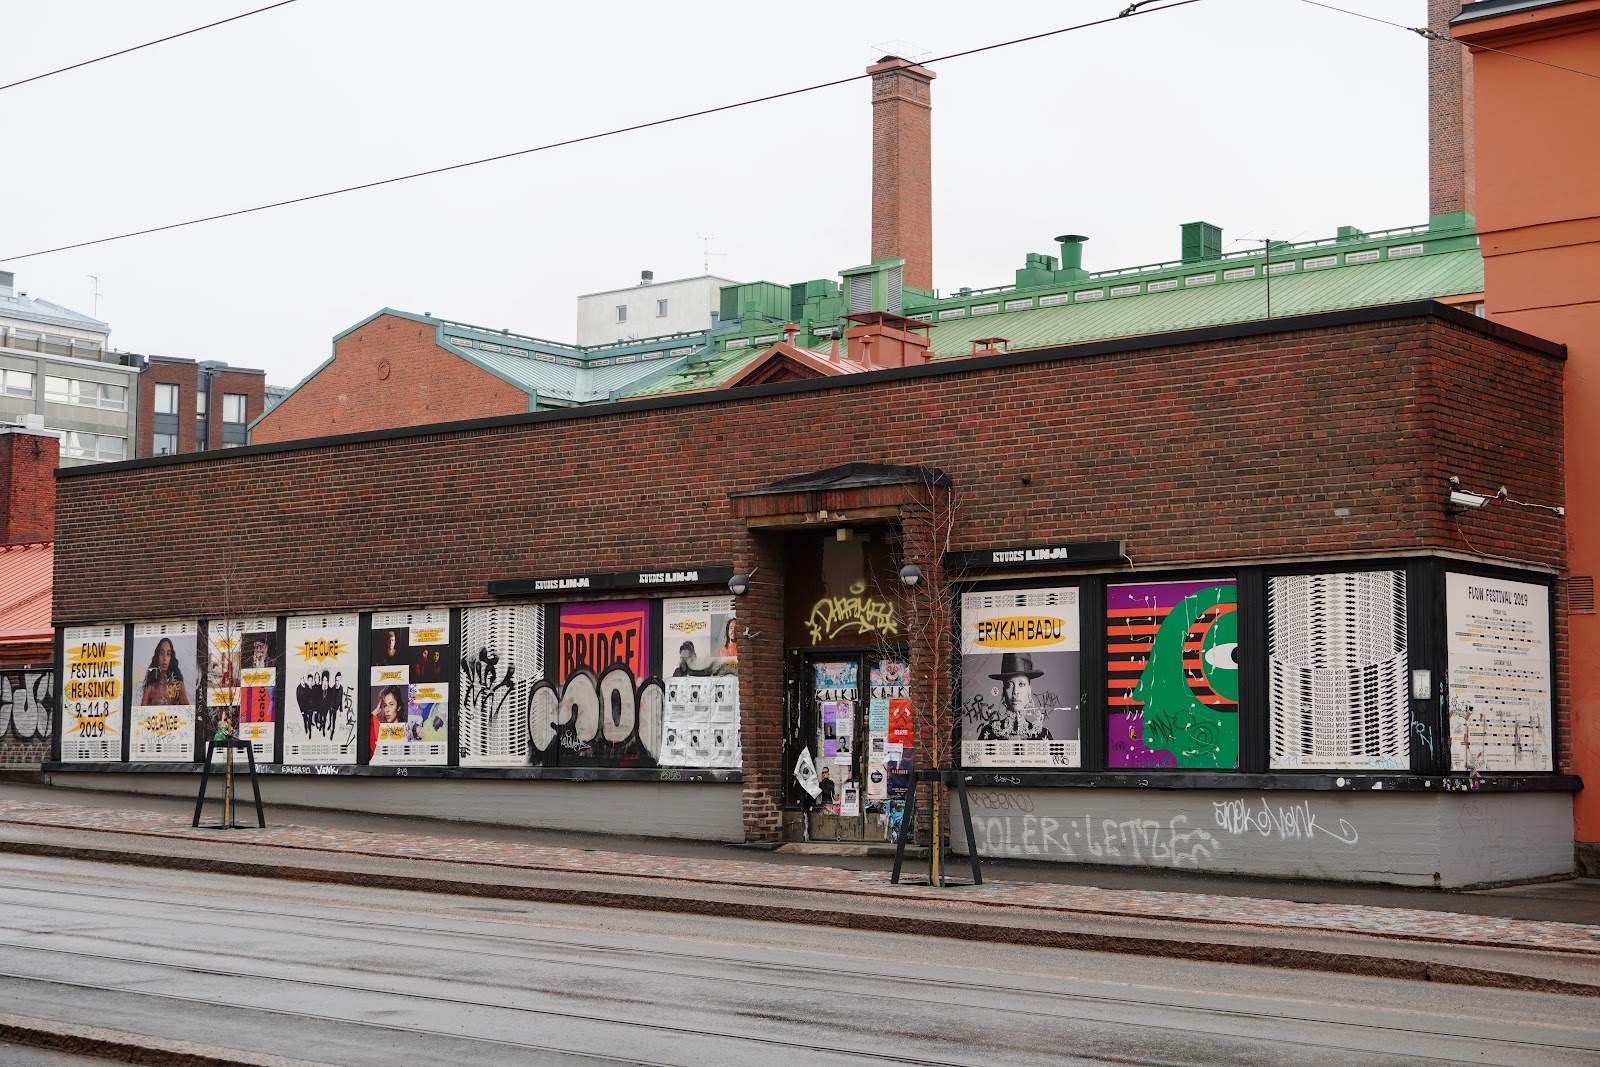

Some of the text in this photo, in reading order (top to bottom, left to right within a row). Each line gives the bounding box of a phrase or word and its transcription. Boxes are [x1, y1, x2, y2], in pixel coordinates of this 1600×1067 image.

[1026, 548, 1068, 560] LINJA
[559, 578, 590, 588] LINJA
[665, 571, 698, 582] LINJA
[1468, 586, 1528, 606] FLOW FESTIVAL 2019
[978, 619, 1061, 641] ERYKAH BADU
[81, 642, 106, 658] FLOW
[305, 640, 338, 657] THE CURE
[71, 661, 115, 678] FESTIVAL
[71, 681, 115, 698] HELSINKI
[816, 688, 857, 700] KAIKU
[80, 722, 104, 737] 2019
[147, 716, 178, 730] SOLANGE
